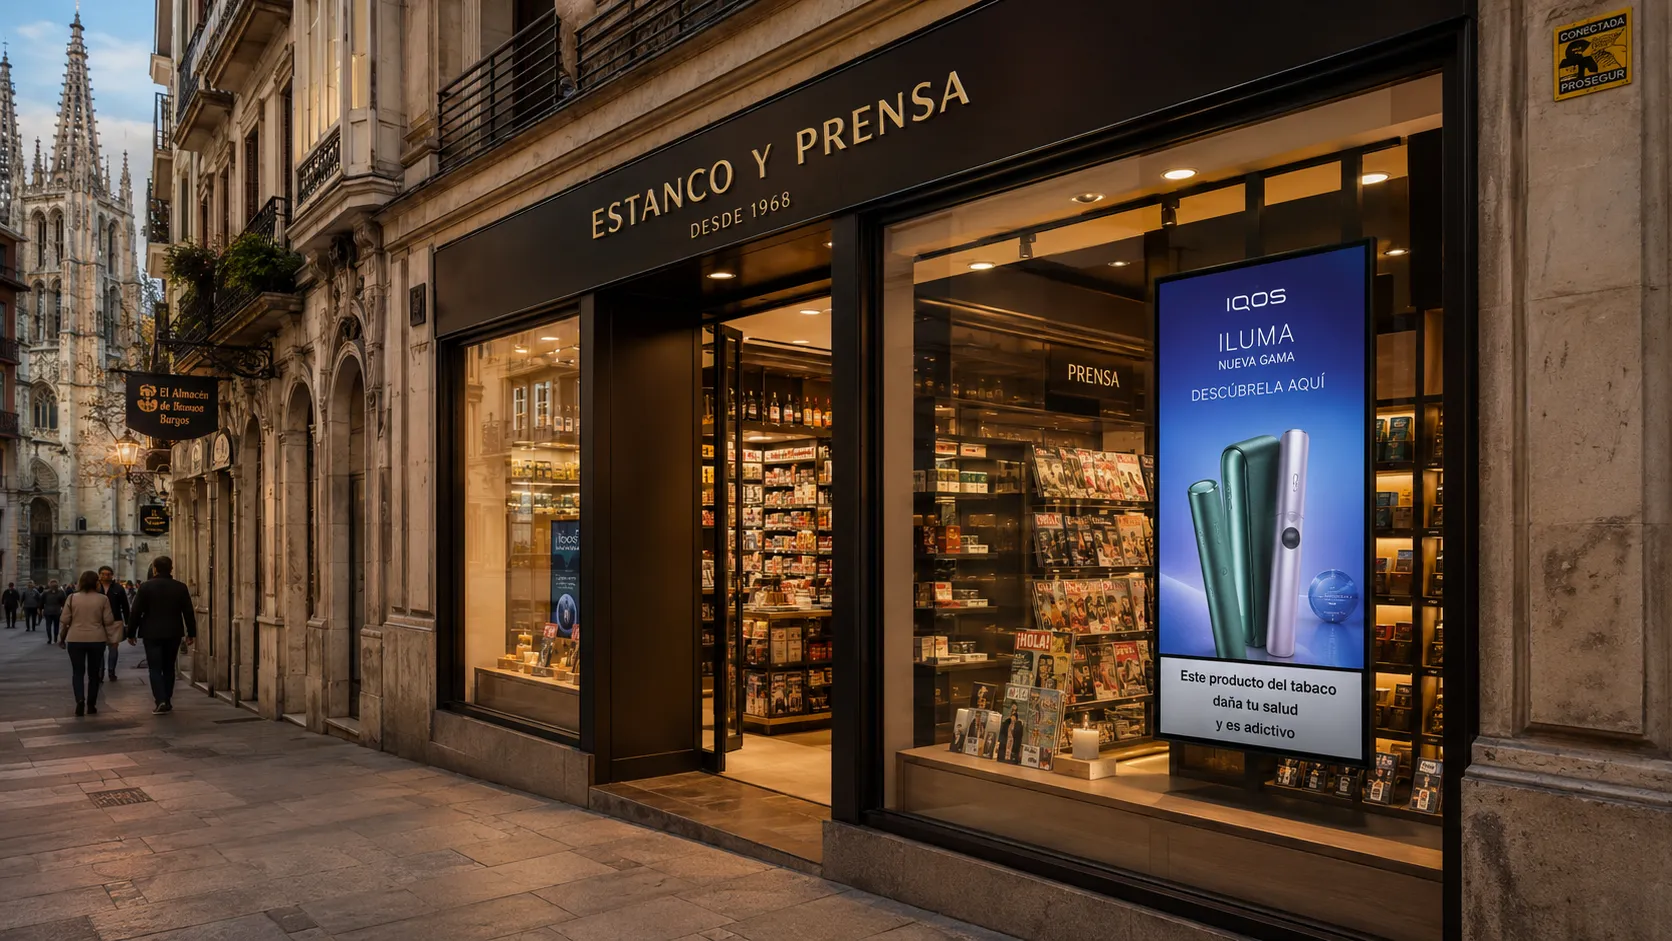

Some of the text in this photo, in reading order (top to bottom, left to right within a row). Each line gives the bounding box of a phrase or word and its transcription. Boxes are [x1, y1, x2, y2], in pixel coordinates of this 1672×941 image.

[1560, 17, 1625, 42] CONECTADA
[1561, 69, 1625, 92] PROSEGUR
[591, 70, 971, 240] ESTANCO Y PRENSA
[690, 191, 791, 239] DESDE 1968
[1226, 288, 1287, 312] IQOS
[1219, 323, 1295, 353] ILUMA
[1218, 351, 1295, 370] NUEVA GAMA
[1068, 363, 1120, 388] PRENSA
[1191, 372, 1326, 402] DESCÚBRELA AQUÍ
[160, 387, 169, 398] El
[160, 401, 170, 411] de
[160, 413, 190, 427] Burgos
[1016, 632, 1050, 650] ¡HOLA!
[1180, 670, 1337, 696] Este producto del tabaco
[1213, 695, 1298, 716] daña tu salud
[1216, 719, 1295, 739] y es adictivo
